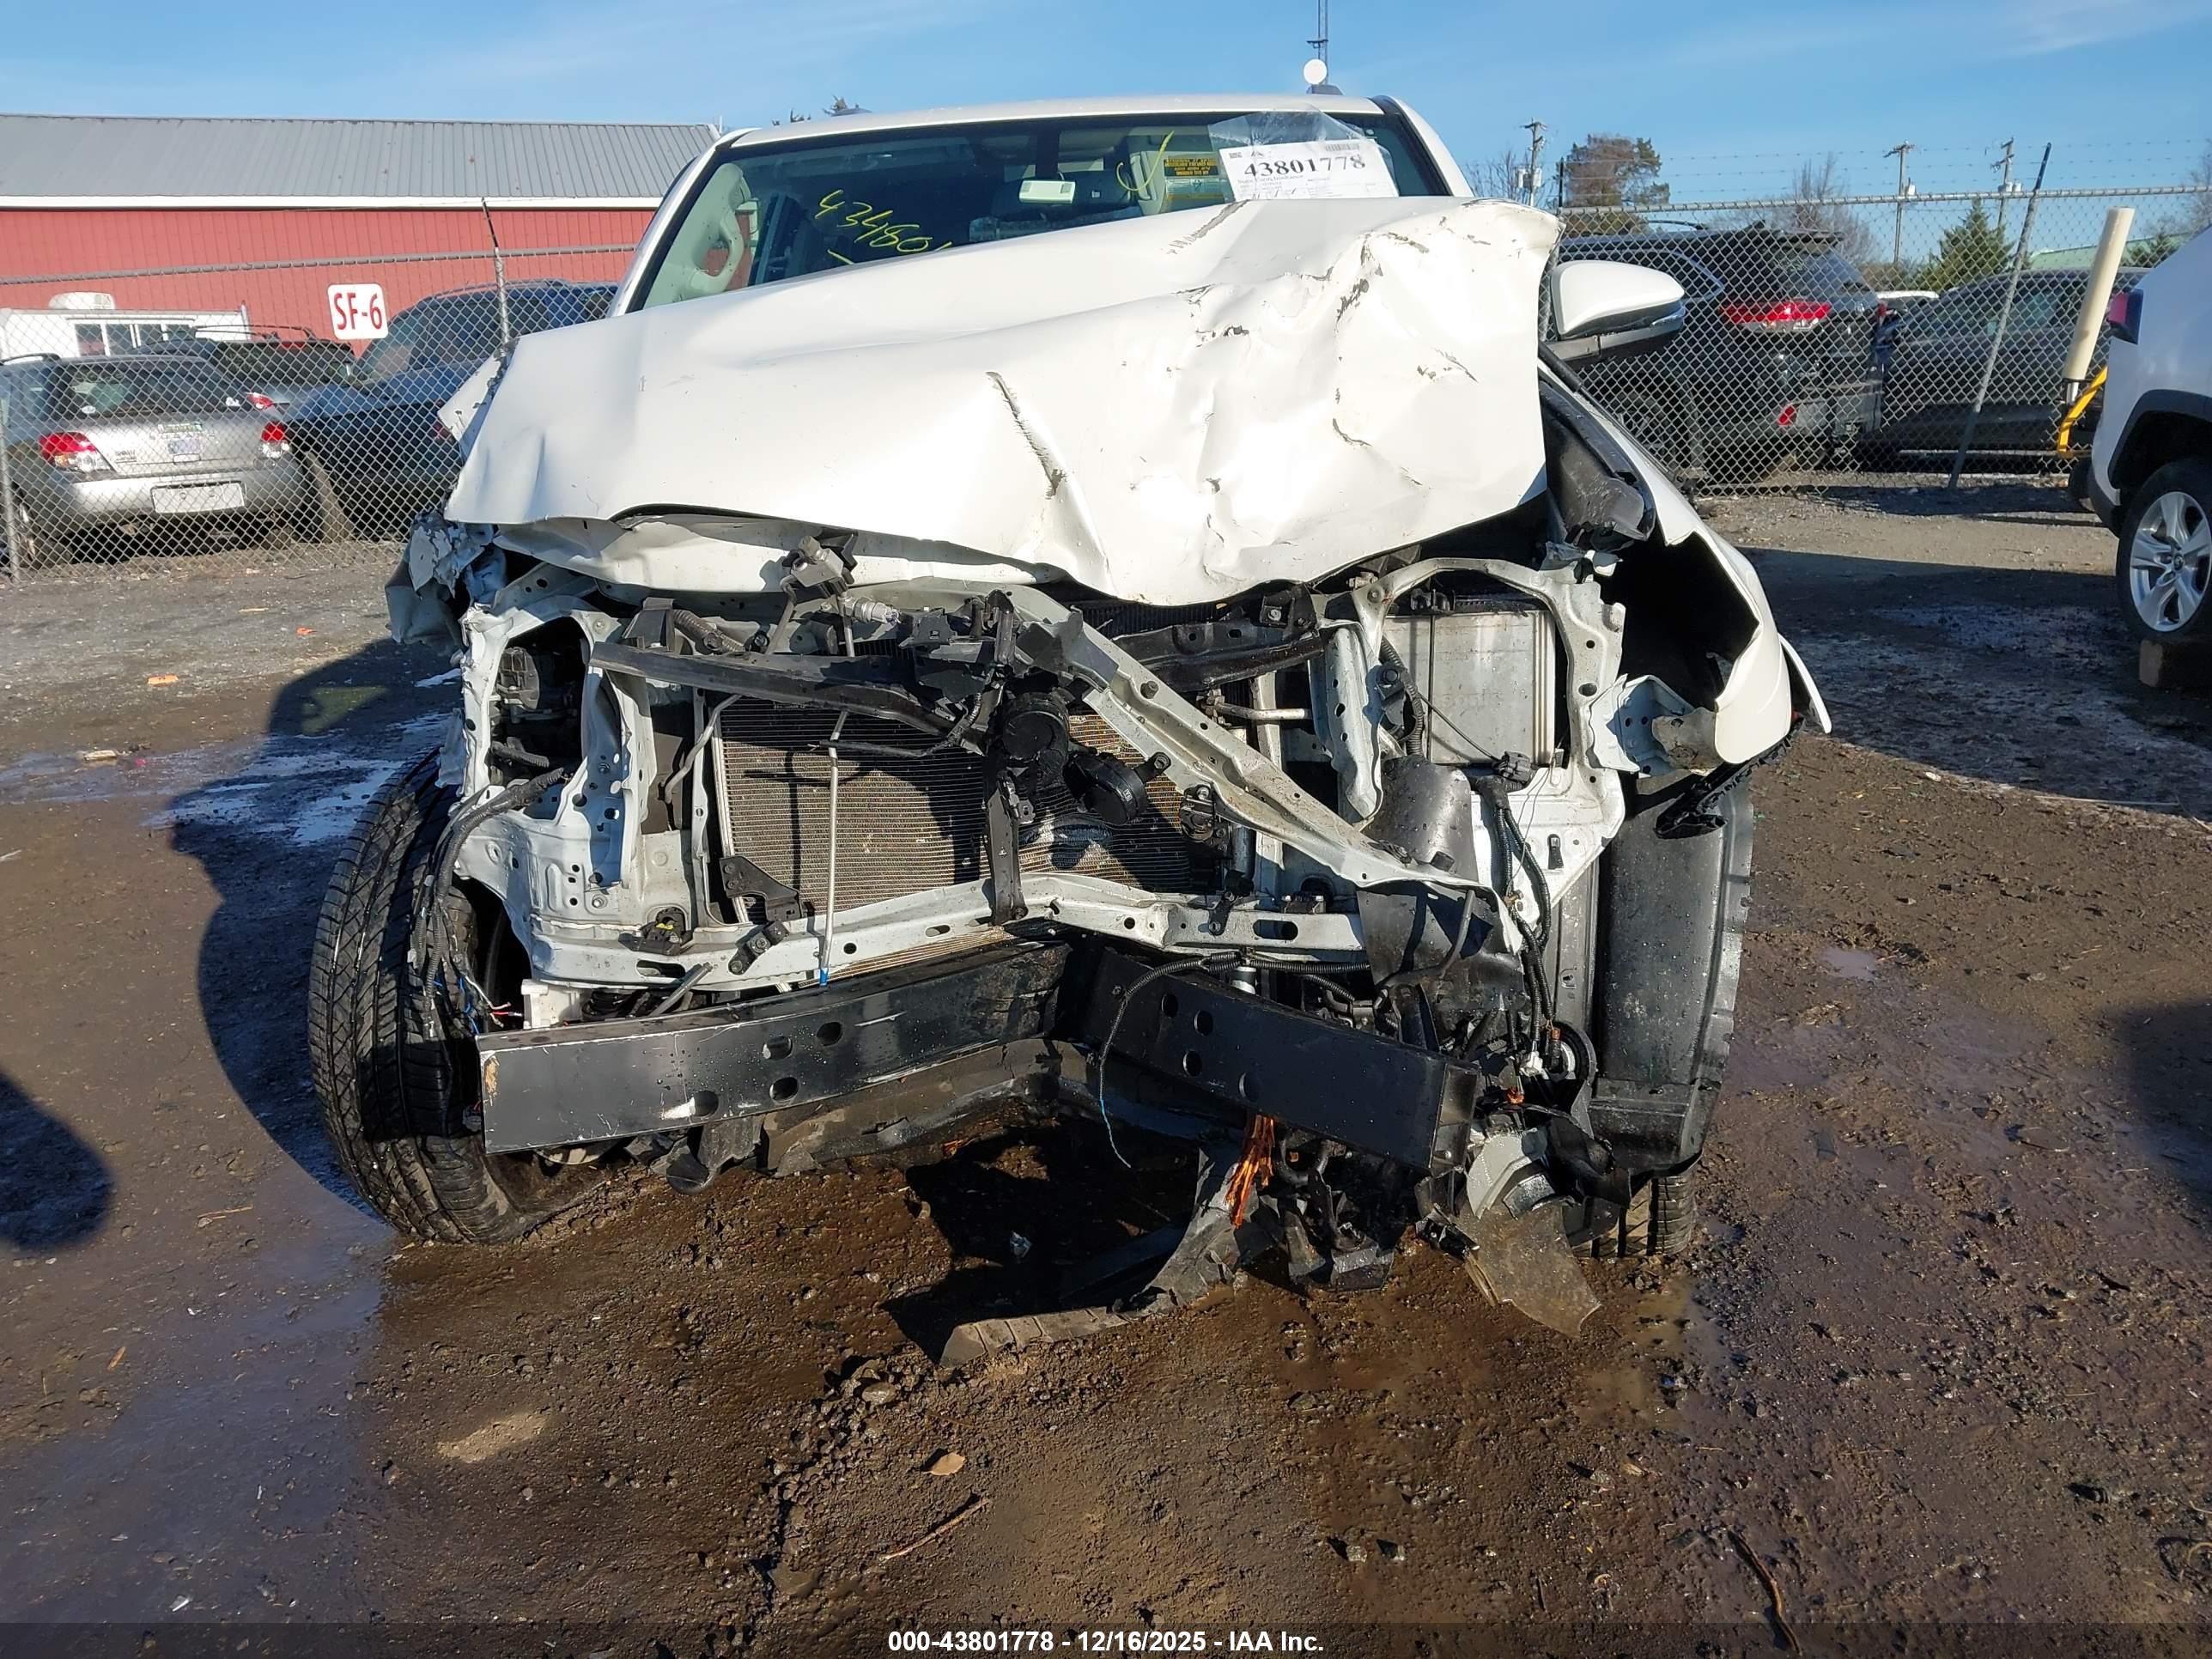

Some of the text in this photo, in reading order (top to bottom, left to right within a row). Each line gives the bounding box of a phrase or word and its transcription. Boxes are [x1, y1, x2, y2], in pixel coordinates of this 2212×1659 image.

[1244, 154, 1366, 178] 43801778
[815, 190, 952, 252] 43480
[333, 292, 383, 331] SF-6
